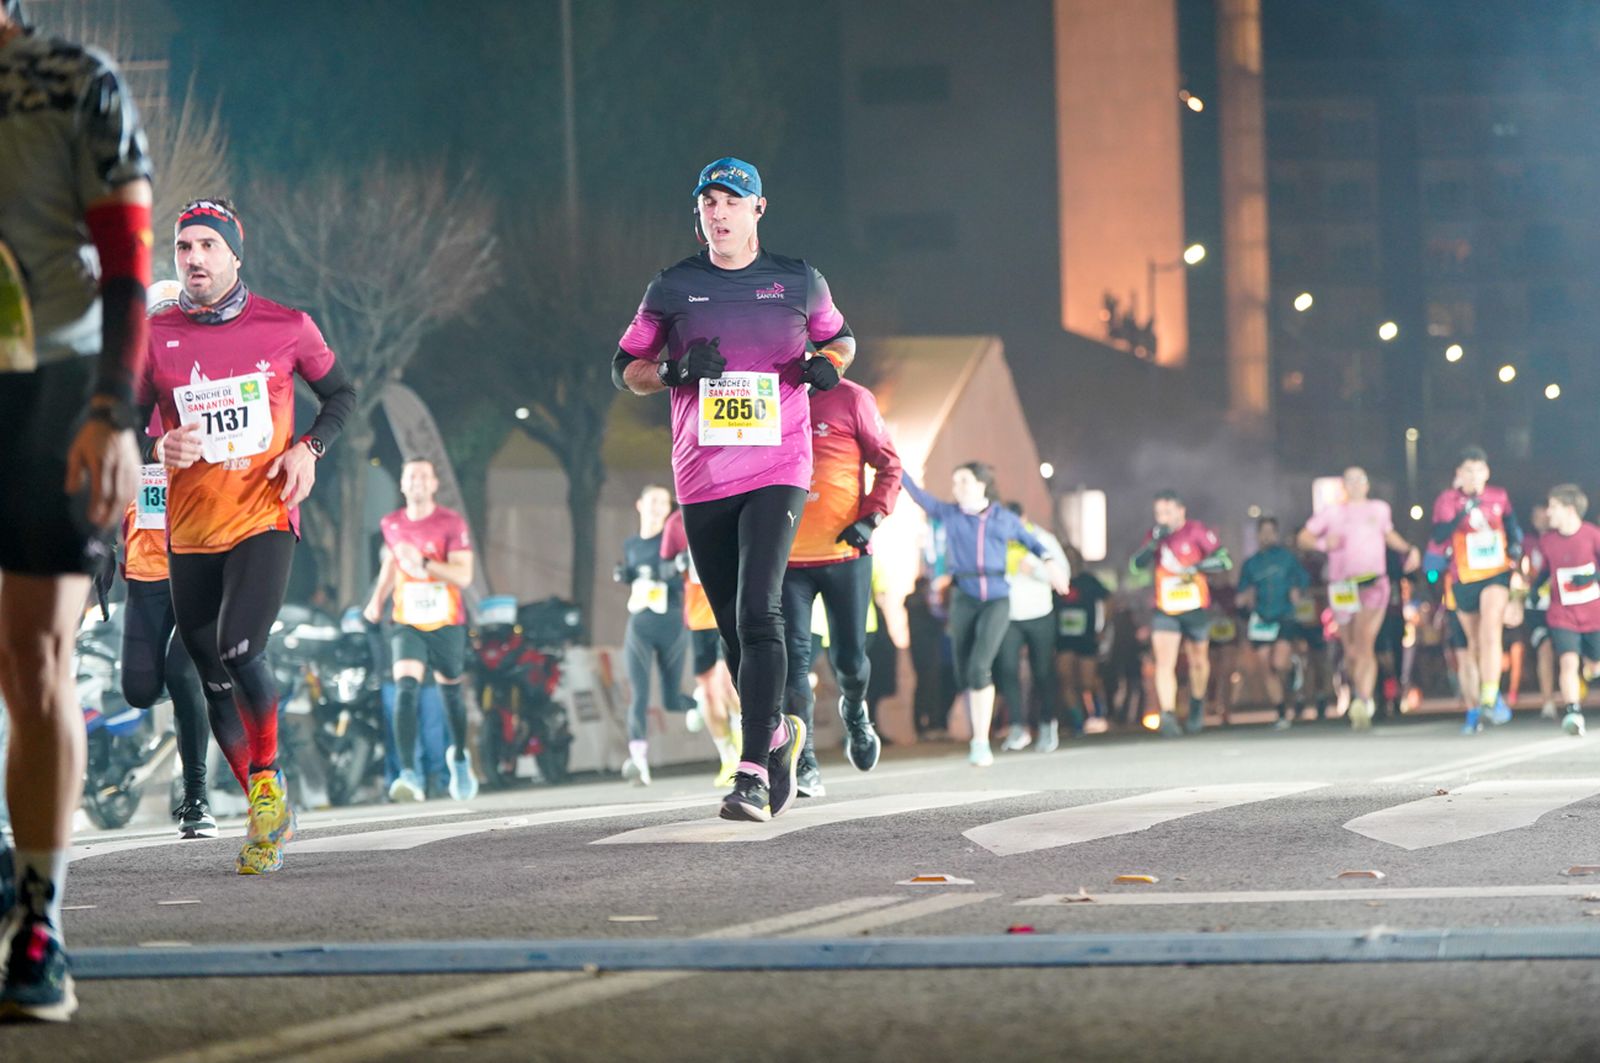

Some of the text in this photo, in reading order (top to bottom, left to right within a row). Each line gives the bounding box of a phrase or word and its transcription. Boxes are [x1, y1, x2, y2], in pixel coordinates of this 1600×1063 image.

[717, 379, 740, 387] NOCHE
[742, 379, 750, 387] DE
[195, 391, 220, 401] NOCHE
[222, 388, 232, 396] DE
[708, 389, 723, 397] SAN
[187, 403, 205, 412] SAN
[713, 398, 766, 420] 2650
[201, 406, 248, 435] 7137
